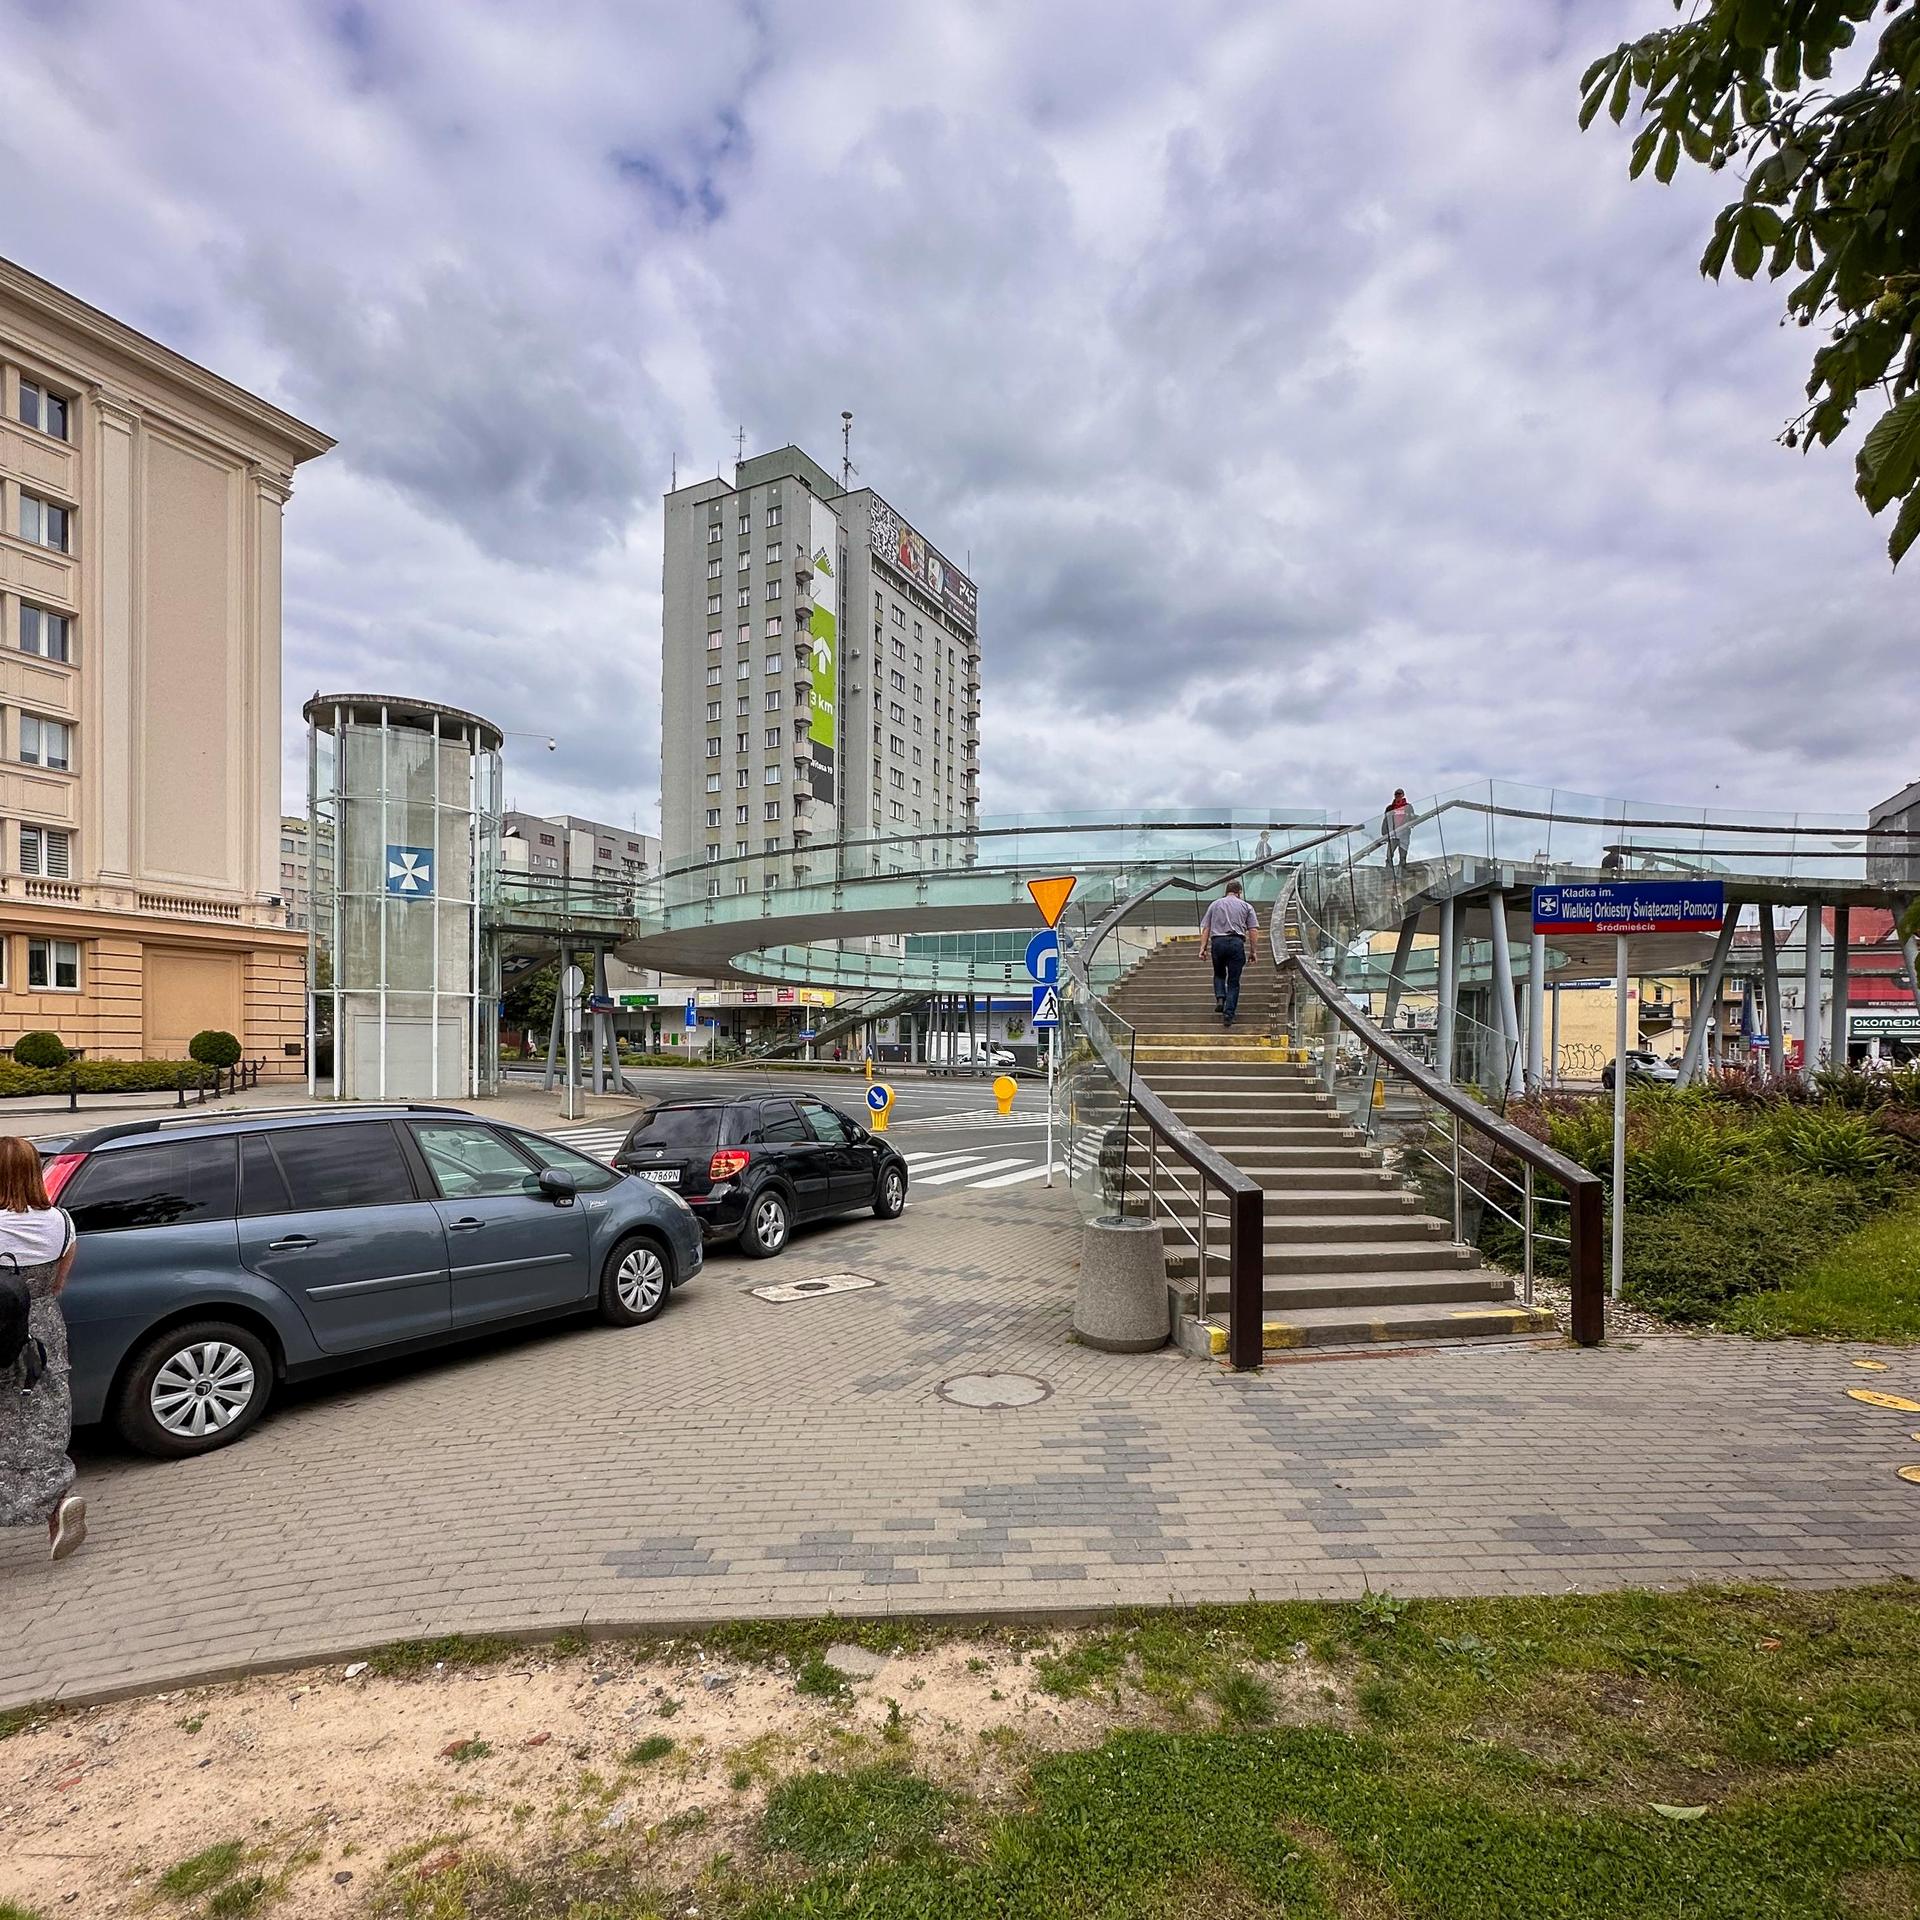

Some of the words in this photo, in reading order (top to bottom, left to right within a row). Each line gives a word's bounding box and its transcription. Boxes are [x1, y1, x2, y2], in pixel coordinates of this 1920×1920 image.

[810, 691, 817, 706] 3
[819, 694, 833, 714] km
[1562, 888, 1596, 898] Kładka
[1599, 888, 1614, 897] im.
[1562, 902, 1593, 922] Wielkiej
[1594, 901, 1631, 921] Orkiestry
[1633, 897, 1682, 920] Świątecznej
[1683, 900, 1717, 920] Pomocy
[1596, 922, 1656, 932] Śródmieście
[653, 1170, 679, 1181] 7869N
